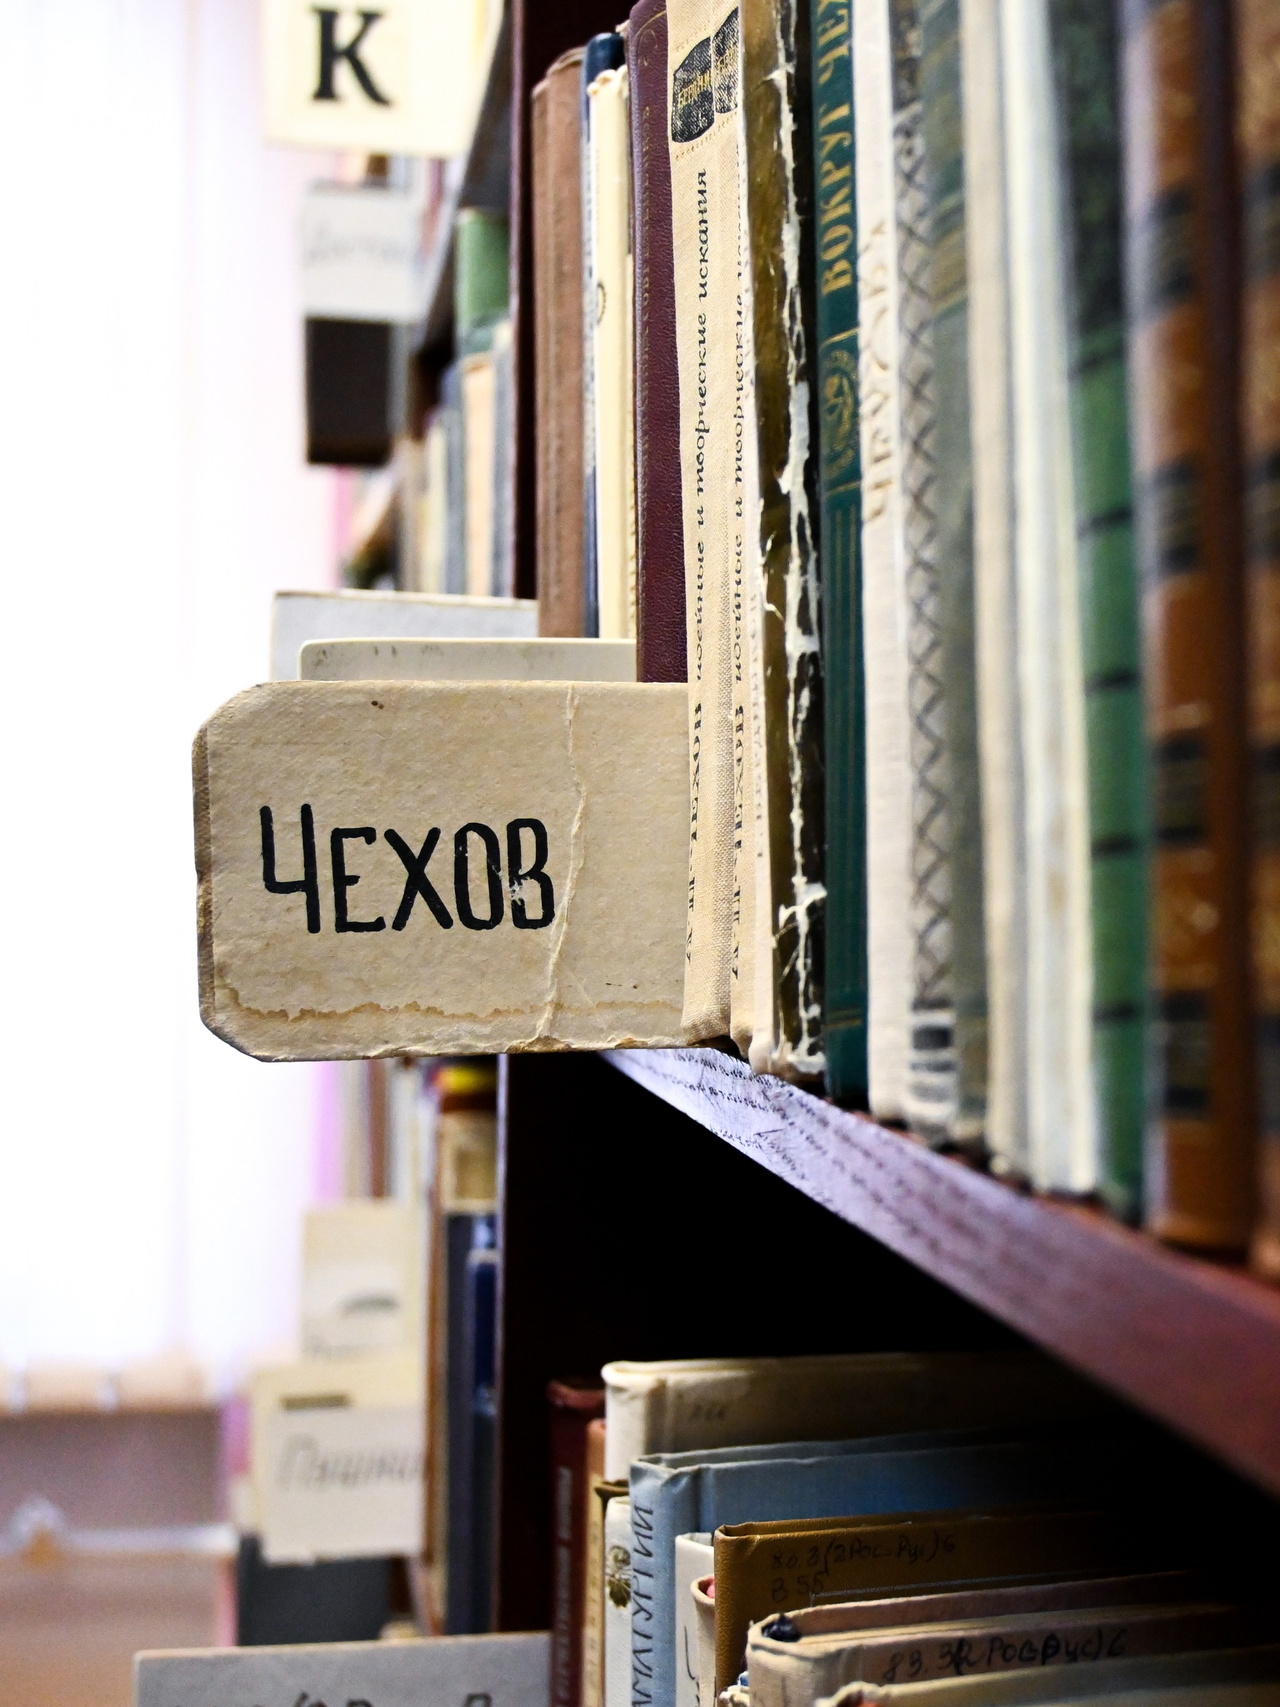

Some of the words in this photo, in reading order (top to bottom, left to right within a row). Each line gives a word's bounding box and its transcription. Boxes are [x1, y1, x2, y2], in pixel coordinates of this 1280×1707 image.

[310, 8, 392, 106] К
[697, 168, 708, 303] искания
[818, 103, 853, 297] ВОКРУГ
[694, 312, 710, 497] творческие
[697, 506, 705, 529] и
[735, 496, 743, 518] и
[260, 804, 555, 934] ЧЕХОВ
